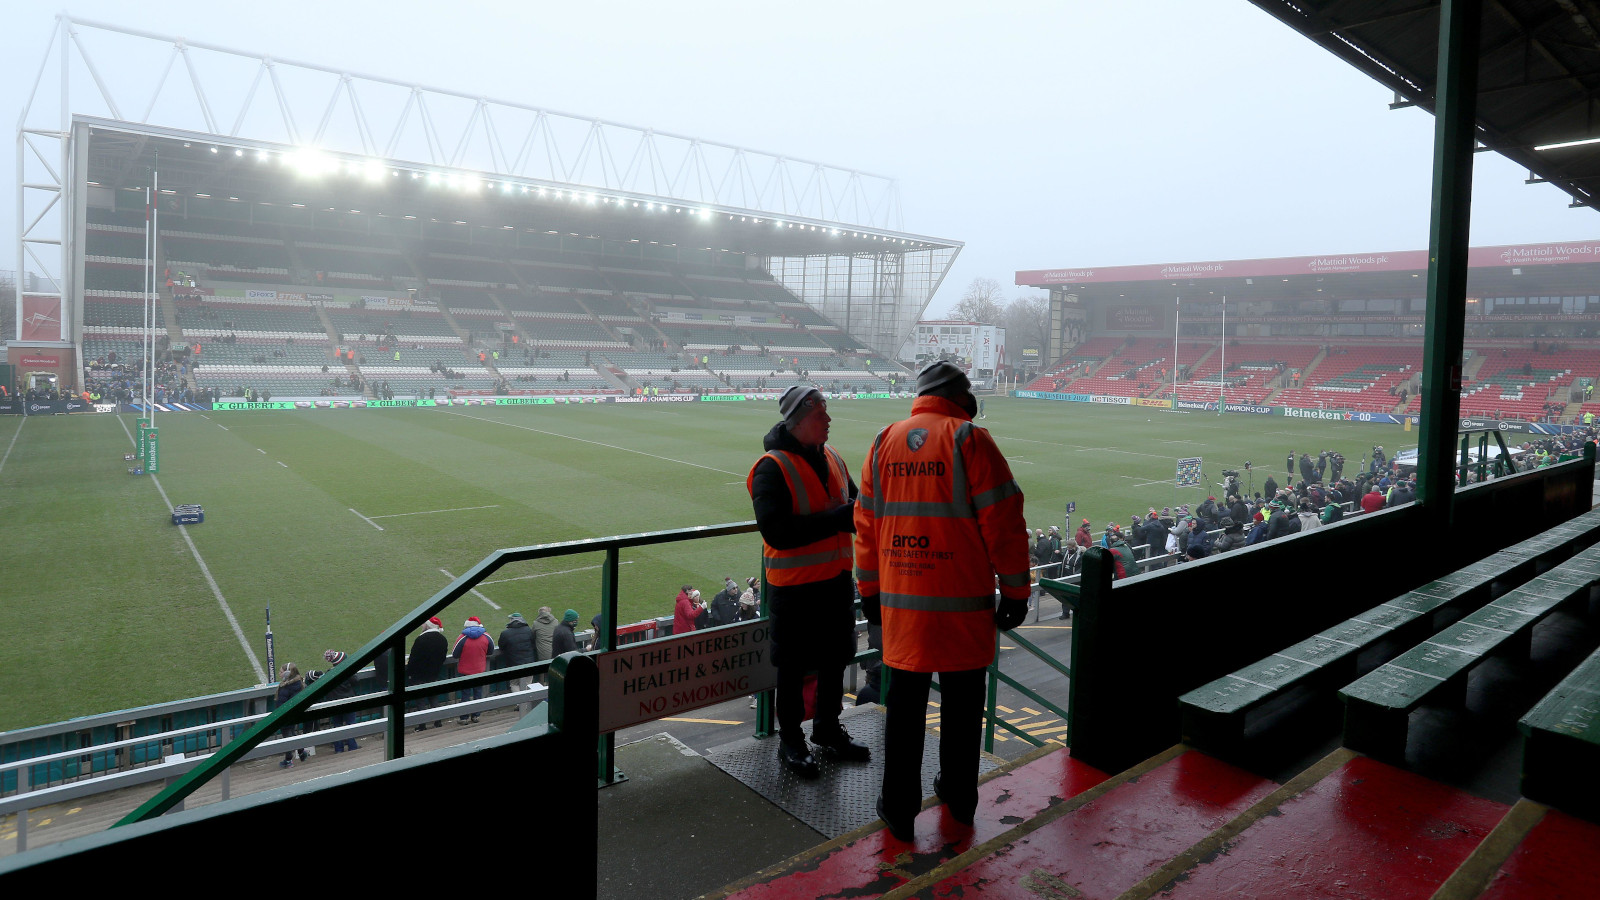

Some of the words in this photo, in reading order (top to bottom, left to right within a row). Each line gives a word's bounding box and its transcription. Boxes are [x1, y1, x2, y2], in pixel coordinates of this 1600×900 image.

[1512, 247, 1552, 257] Mattioli
[1556, 245, 1591, 255] Woods
[1317, 258, 1347, 266] Mattioli
[1350, 257, 1375, 265] Woods
[1377, 256, 1388, 265] plc
[1192, 264, 1214, 272] Woods
[1214, 264, 1224, 272] plc
[918, 334, 972, 344] HÄFELE
[1102, 396, 1129, 404] TISSOT
[229, 402, 274, 410] GILBERT
[1216, 404, 1254, 413] CAMPIONS
[1284, 408, 1340, 420] Heineken
[887, 461, 946, 477] STEWARD
[892, 534, 930, 548] arco
[904, 550, 930, 559] SAFETY
[932, 552, 954, 560] FIRST
[614, 655, 632, 674] IN
[640, 648, 672, 668] THE
[678, 631, 748, 660] INTEREST
[624, 666, 690, 696] HEALTH
[695, 663, 707, 678] &
[712, 649, 764, 674] SAFETY
[639, 696, 667, 717] NO
[672, 674, 750, 708] SMOKING
